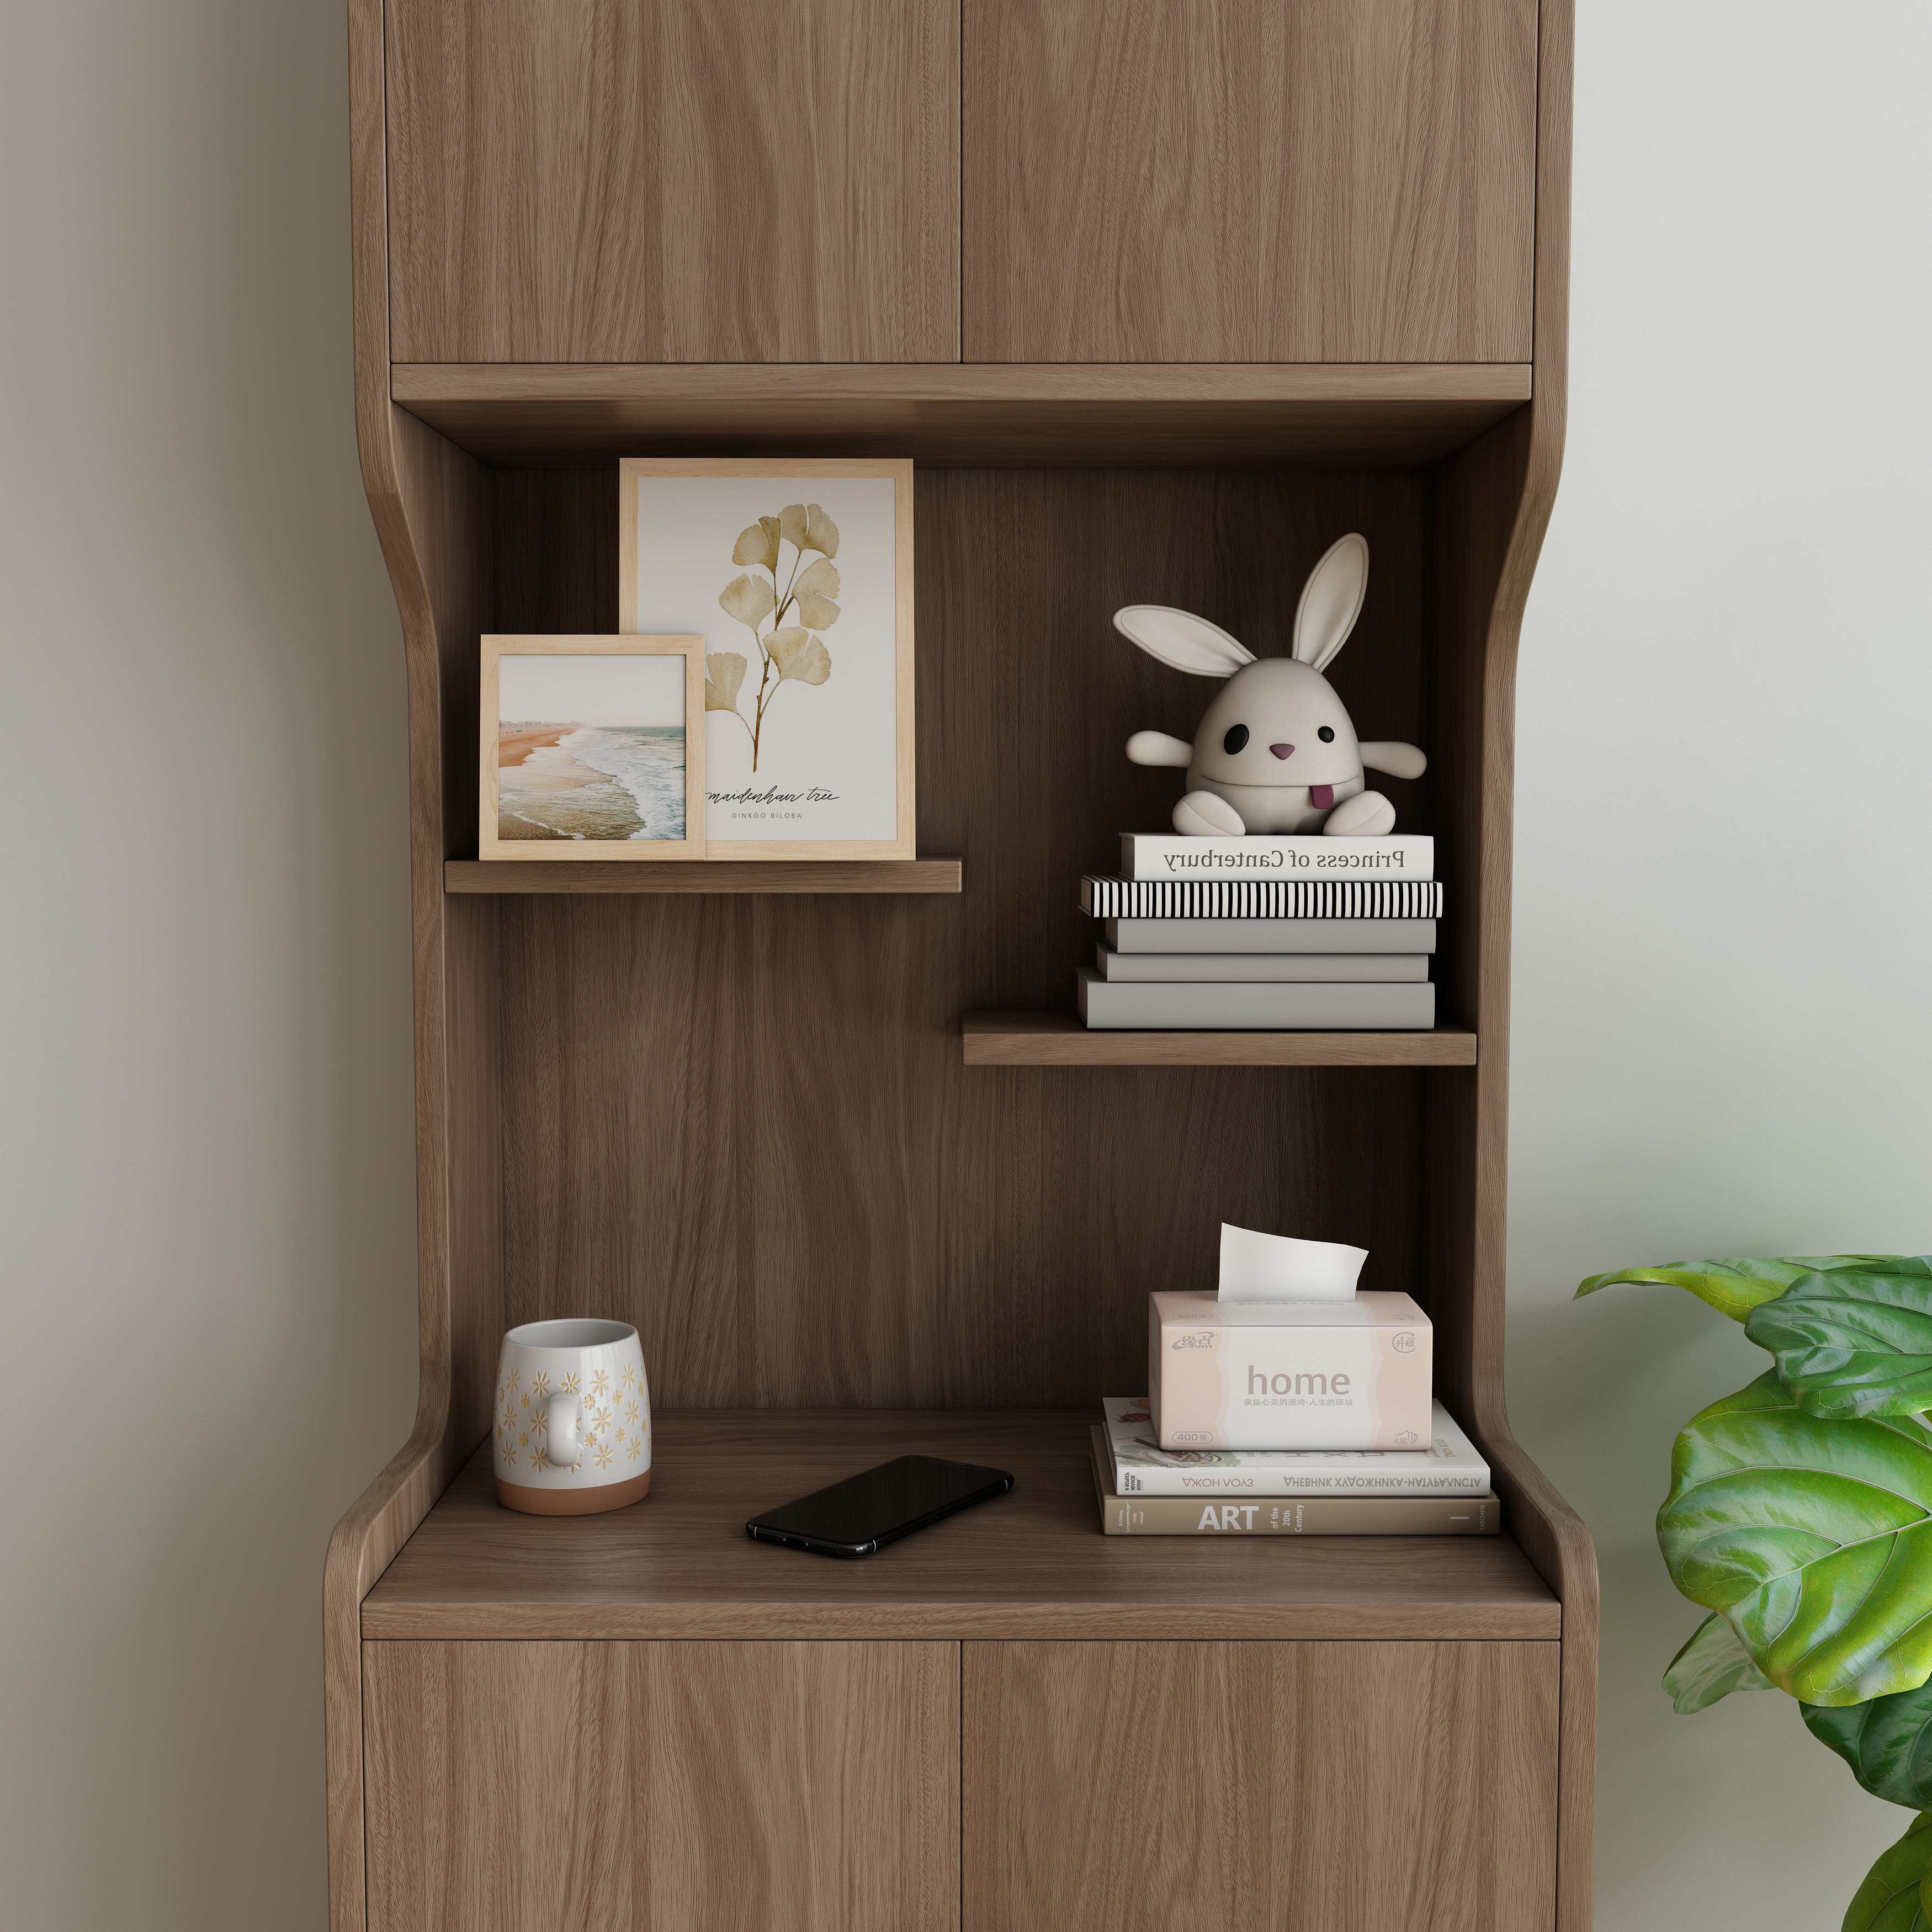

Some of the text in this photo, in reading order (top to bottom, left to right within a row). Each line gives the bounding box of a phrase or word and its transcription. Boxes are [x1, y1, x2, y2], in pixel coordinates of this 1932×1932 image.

[705, 786, 839, 804] maidenhair tree
[1395, 1337, 1414, 1351] 升级
[1249, 1365, 1350, 1395] home
[1198, 1506, 1259, 1529] ART
[1271, 1517, 1278, 1528] of
[1296, 1504, 1304, 1531] Century
